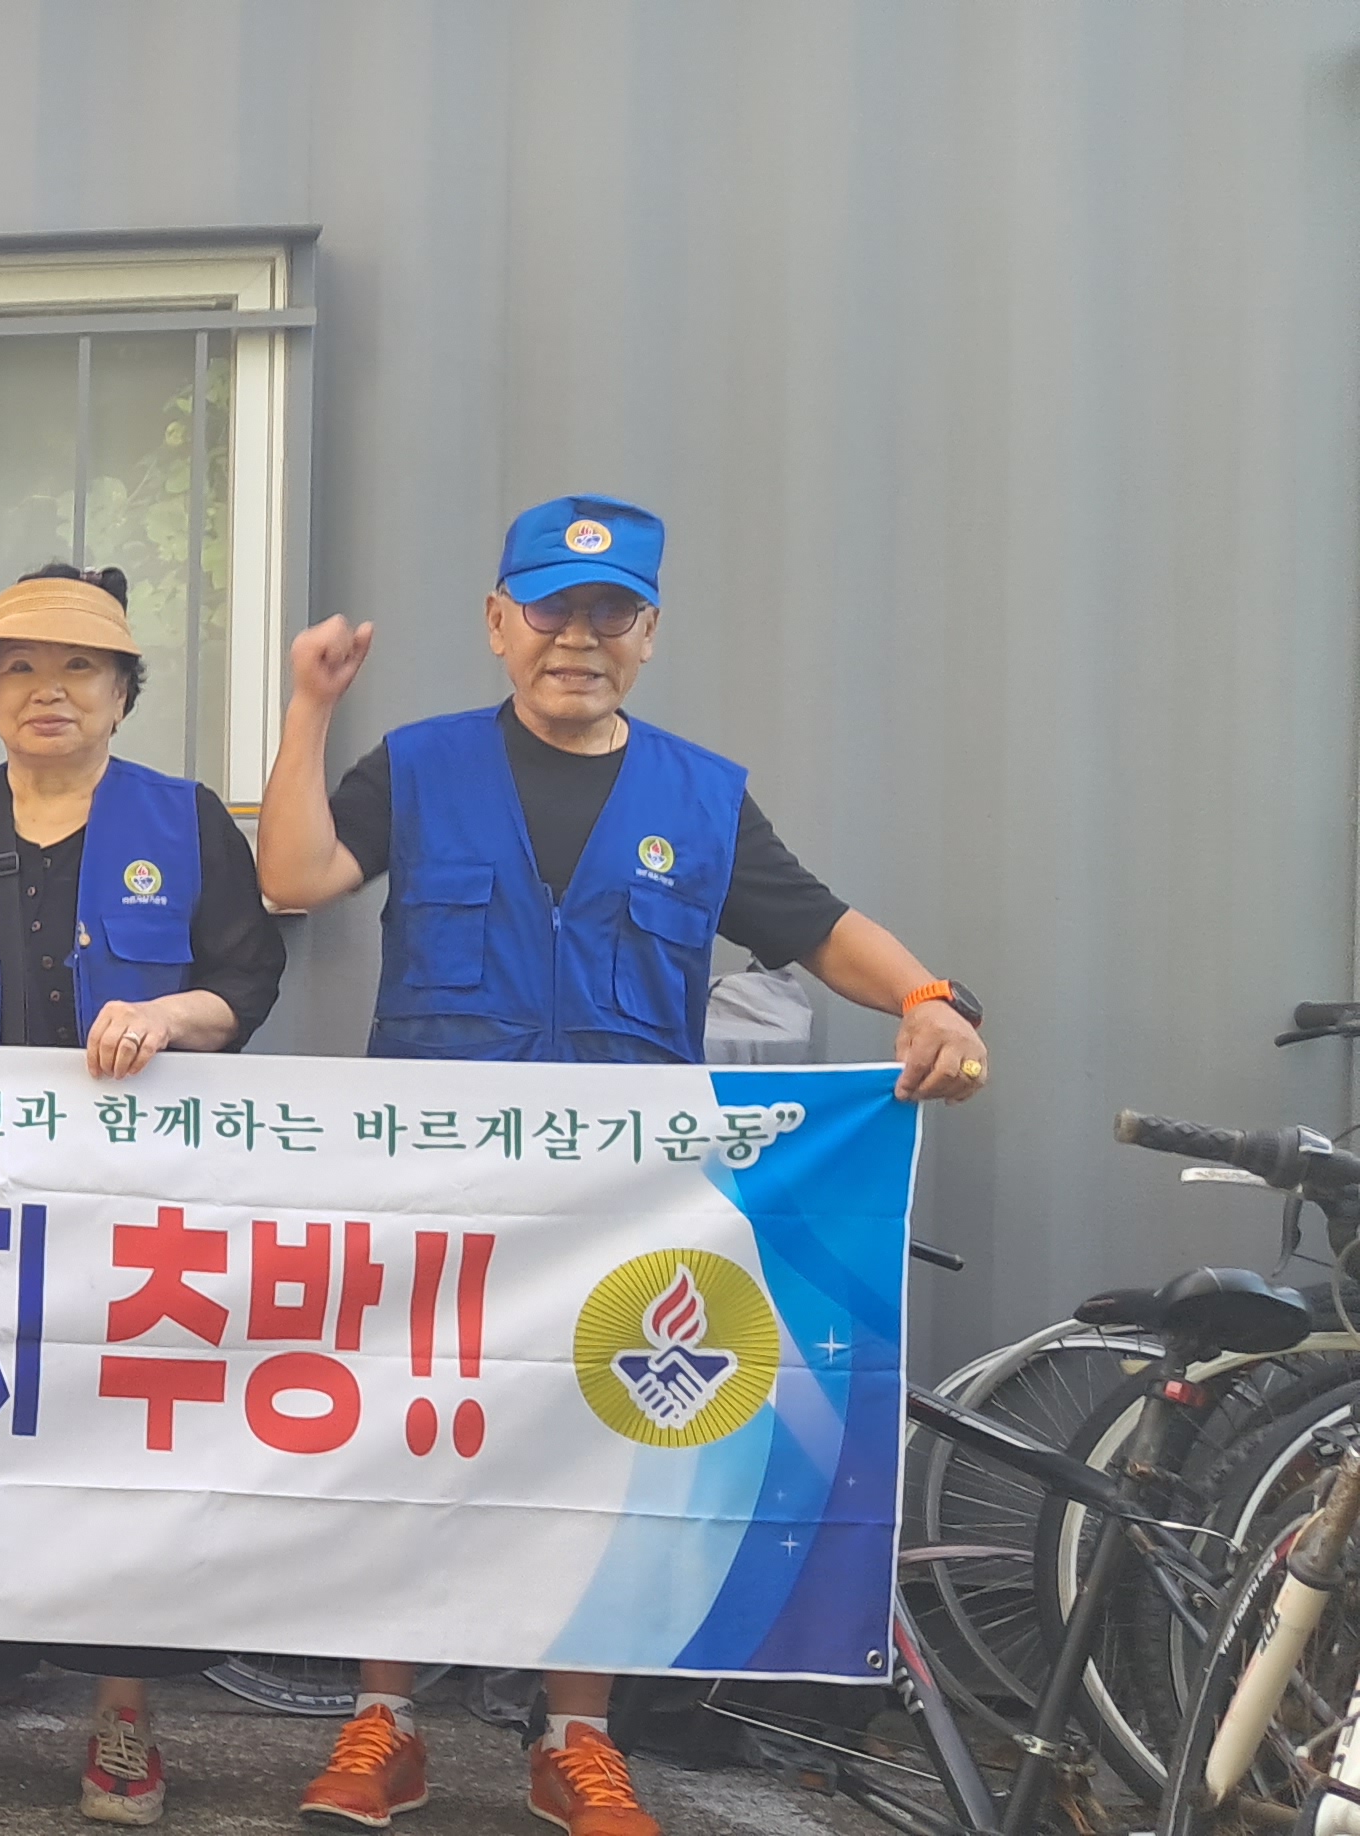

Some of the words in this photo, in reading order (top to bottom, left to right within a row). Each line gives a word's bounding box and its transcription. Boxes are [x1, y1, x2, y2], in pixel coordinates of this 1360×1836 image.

[94, 1094, 324, 1151] 함께하는
[354, 1104, 798, 1164] 바르게살기운동”
[99, 1206, 495, 1458] 추방!!
